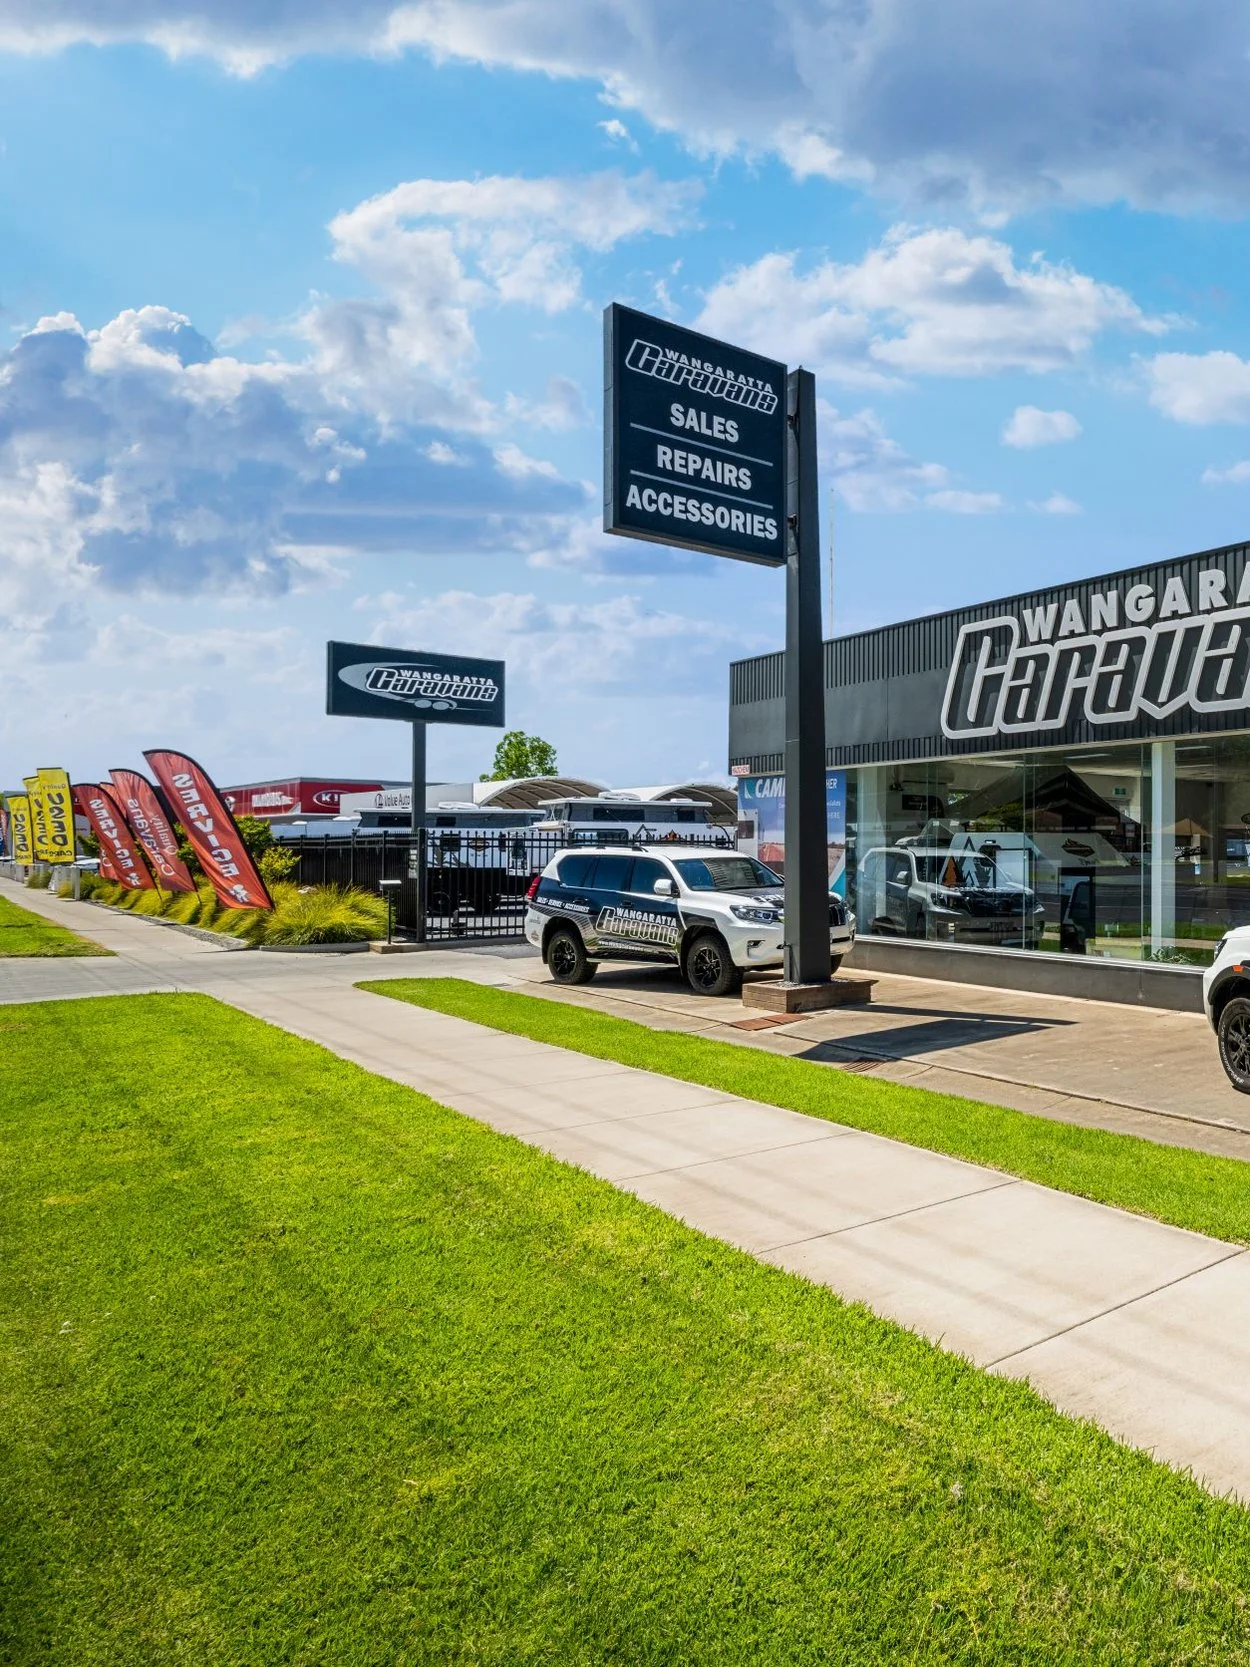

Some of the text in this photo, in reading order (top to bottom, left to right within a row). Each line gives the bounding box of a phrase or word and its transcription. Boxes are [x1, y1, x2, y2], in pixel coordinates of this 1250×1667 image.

[625, 338, 778, 415] Caravans
[665, 348, 773, 394] WANGARATTA
[670, 403, 739, 443] SALES
[657, 444, 752, 491] REPAIRS
[625, 484, 778, 541] ACCESSORIES
[366, 667, 498, 701] Caravans
[400, 669, 494, 686] WANGARATTA
[595, 905, 679, 946] Caravans
[616, 907, 677, 927] WANGARATTA
